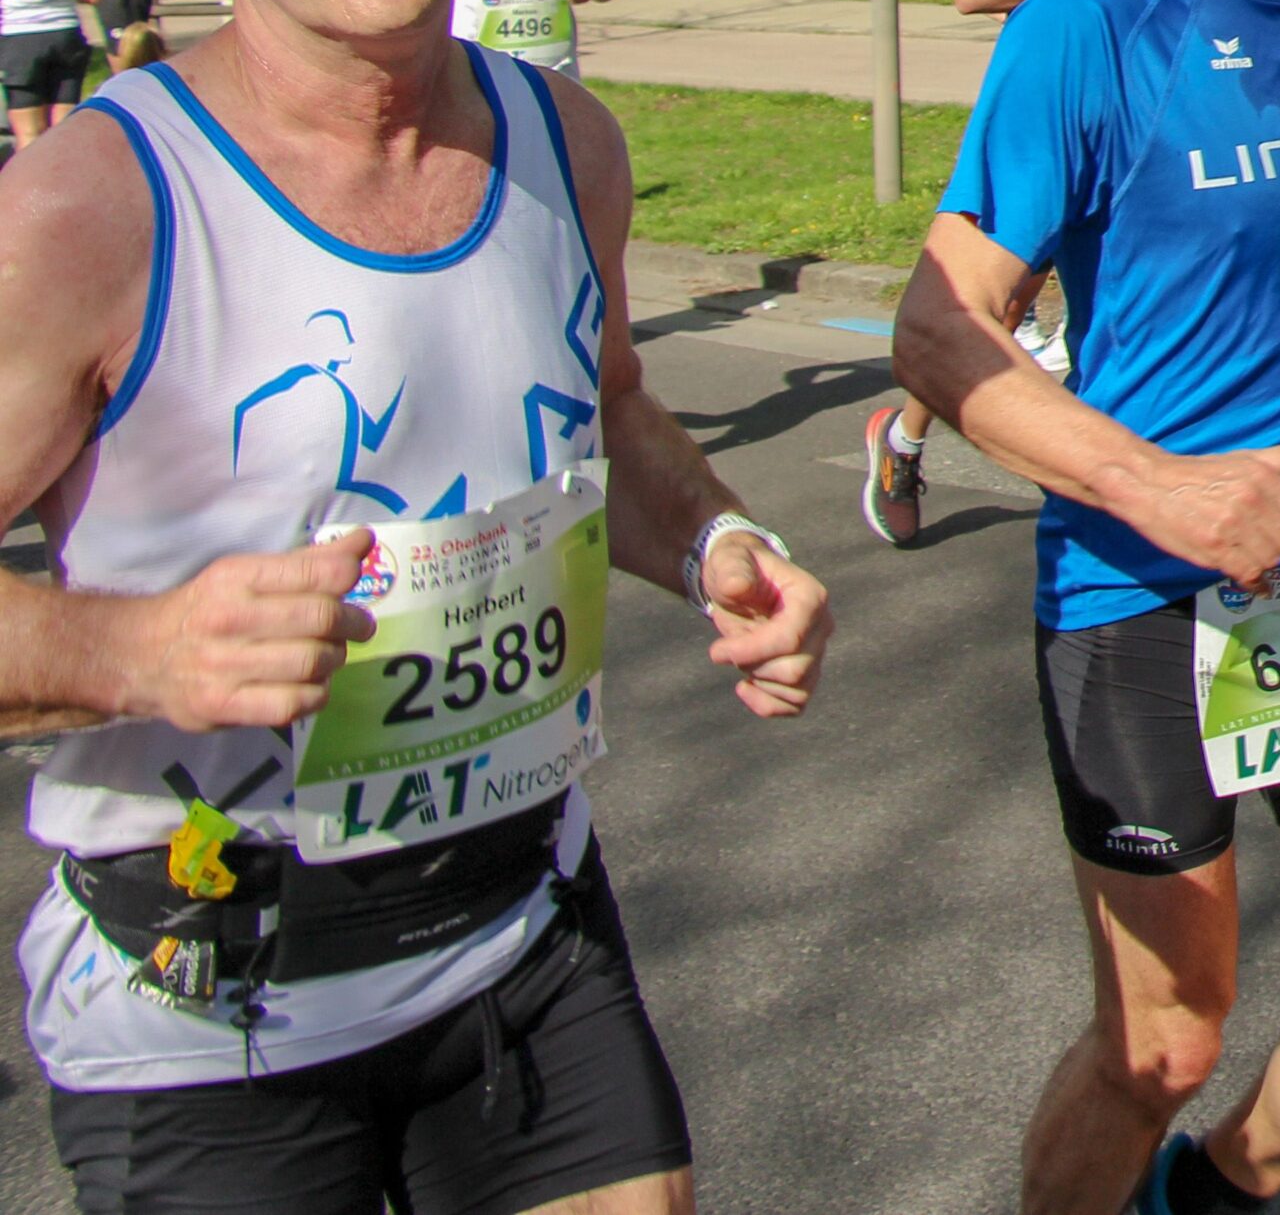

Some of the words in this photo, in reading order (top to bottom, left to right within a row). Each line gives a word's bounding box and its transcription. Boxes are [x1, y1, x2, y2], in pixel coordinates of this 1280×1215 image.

[496, 17, 553, 37] 4496
[1210, 55, 1253, 70] erima
[411, 558, 450, 577] LINZ
[460, 539, 511, 566] DONAU
[441, 522, 508, 557] Oberbank
[411, 554, 512, 593] MARATHON
[444, 585, 527, 629] Herbert
[382, 606, 567, 727] 2589
[1220, 717, 1245, 733] LAT
[328, 760, 366, 779] LAT
[379, 732, 480, 768] NITROGEN
[343, 757, 471, 841] LAT
[484, 732, 600, 809] Nitrogen
[1105, 837, 1181, 855] skinfit
